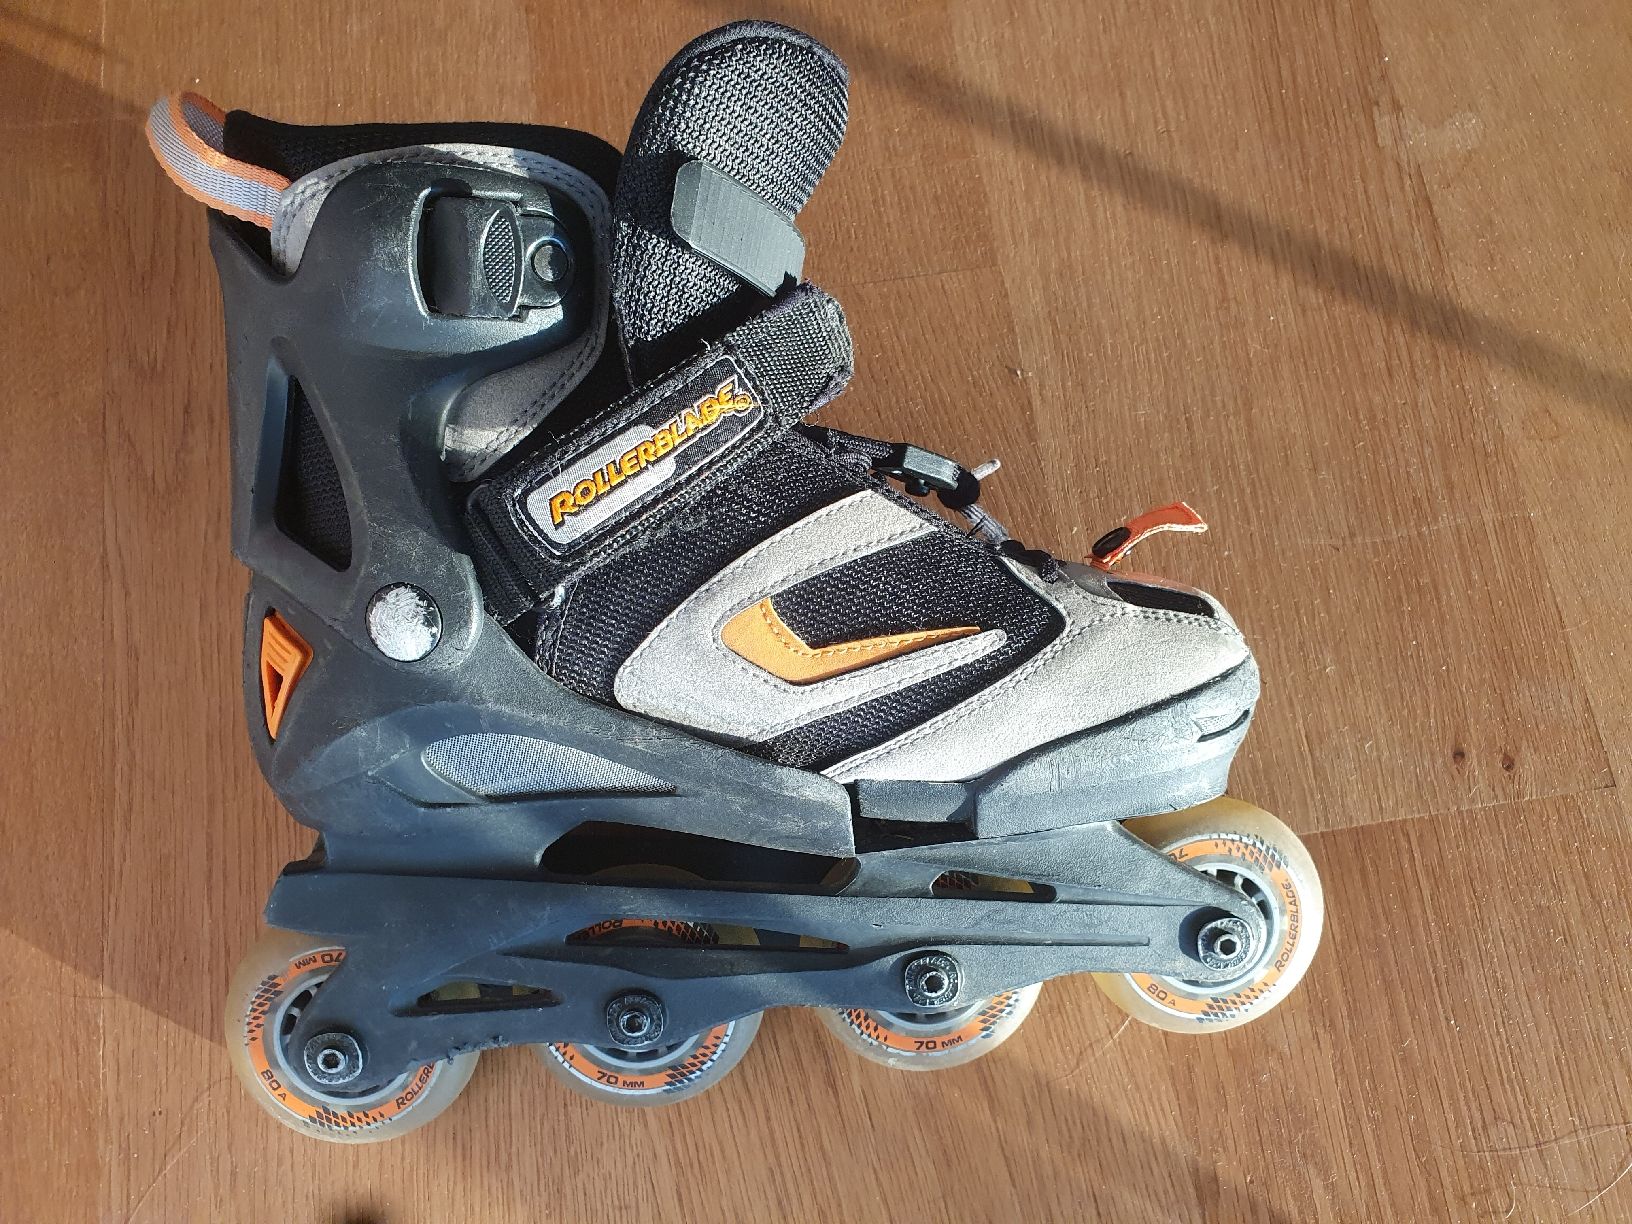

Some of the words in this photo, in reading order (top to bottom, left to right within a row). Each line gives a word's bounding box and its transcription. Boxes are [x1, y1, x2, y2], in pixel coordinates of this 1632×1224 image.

[549, 376, 749, 529] ROLLERBLADE
[1274, 880, 1300, 973] ROLLERBLADE
[294, 954, 317, 970] MM
[320, 951, 344, 964] 70
[1146, 983, 1168, 1002] 80
[1168, 998, 1177, 1007] A
[913, 1039, 938, 1051] 70
[941, 1035, 964, 1049] MM
[260, 1068, 283, 1092] 80
[277, 1091, 288, 1102] A
[596, 1069, 619, 1086] 70
[622, 1079, 645, 1089] MM
